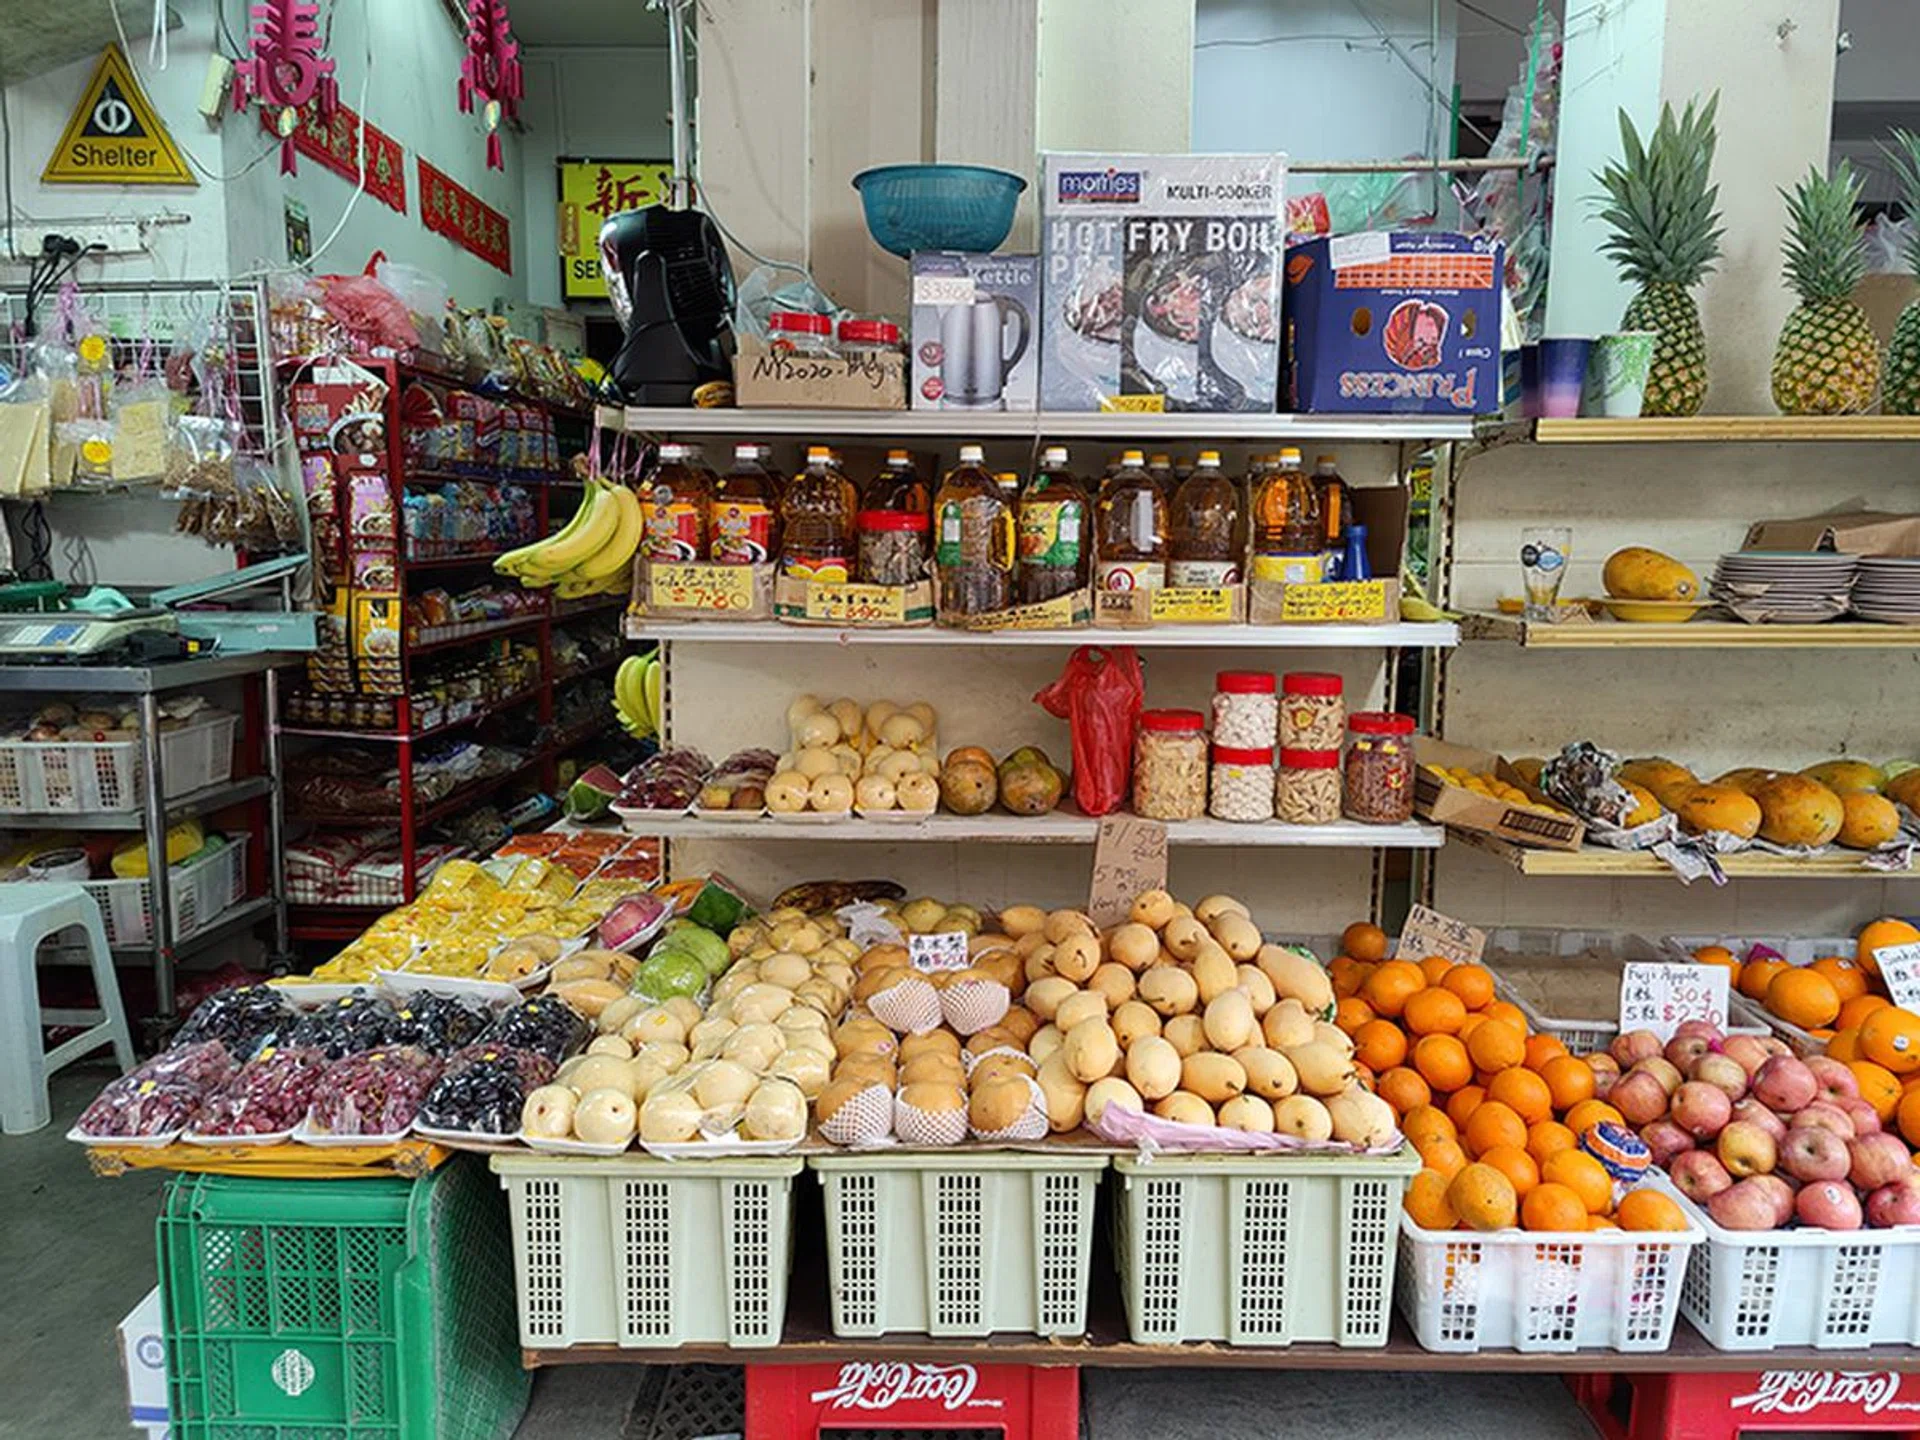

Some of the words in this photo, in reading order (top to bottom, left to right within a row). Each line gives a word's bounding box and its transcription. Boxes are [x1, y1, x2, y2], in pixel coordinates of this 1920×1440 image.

[72, 143, 157, 166] Shelter
[1052, 221, 1118, 251] HOT
[1128, 221, 1194, 253] FRY
[968, 267, 1032, 284] Kettle
[1338, 367, 1478, 409] PRINCESS
[1627, 965, 1656, 985] Fuji
[1660, 966, 1702, 986] Apple
